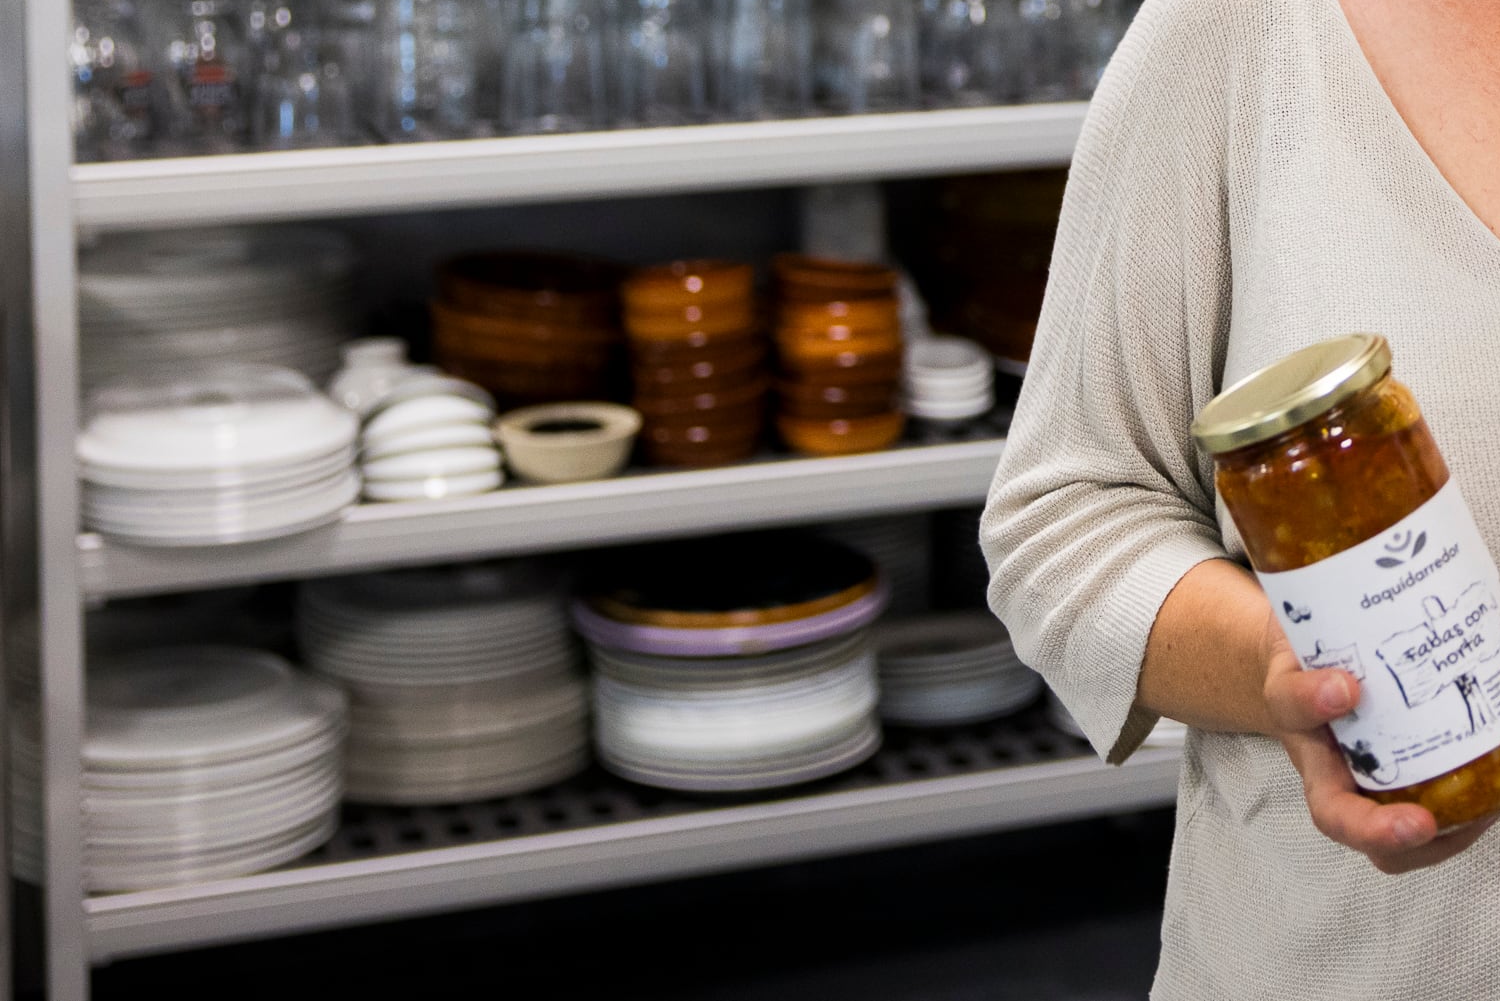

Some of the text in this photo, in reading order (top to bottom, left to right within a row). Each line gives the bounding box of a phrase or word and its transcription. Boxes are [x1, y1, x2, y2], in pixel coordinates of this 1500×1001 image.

[1360, 542, 1459, 609] daquidarredor
[1403, 603, 1489, 662] Fabas con
[1432, 633, 1486, 672] horta
